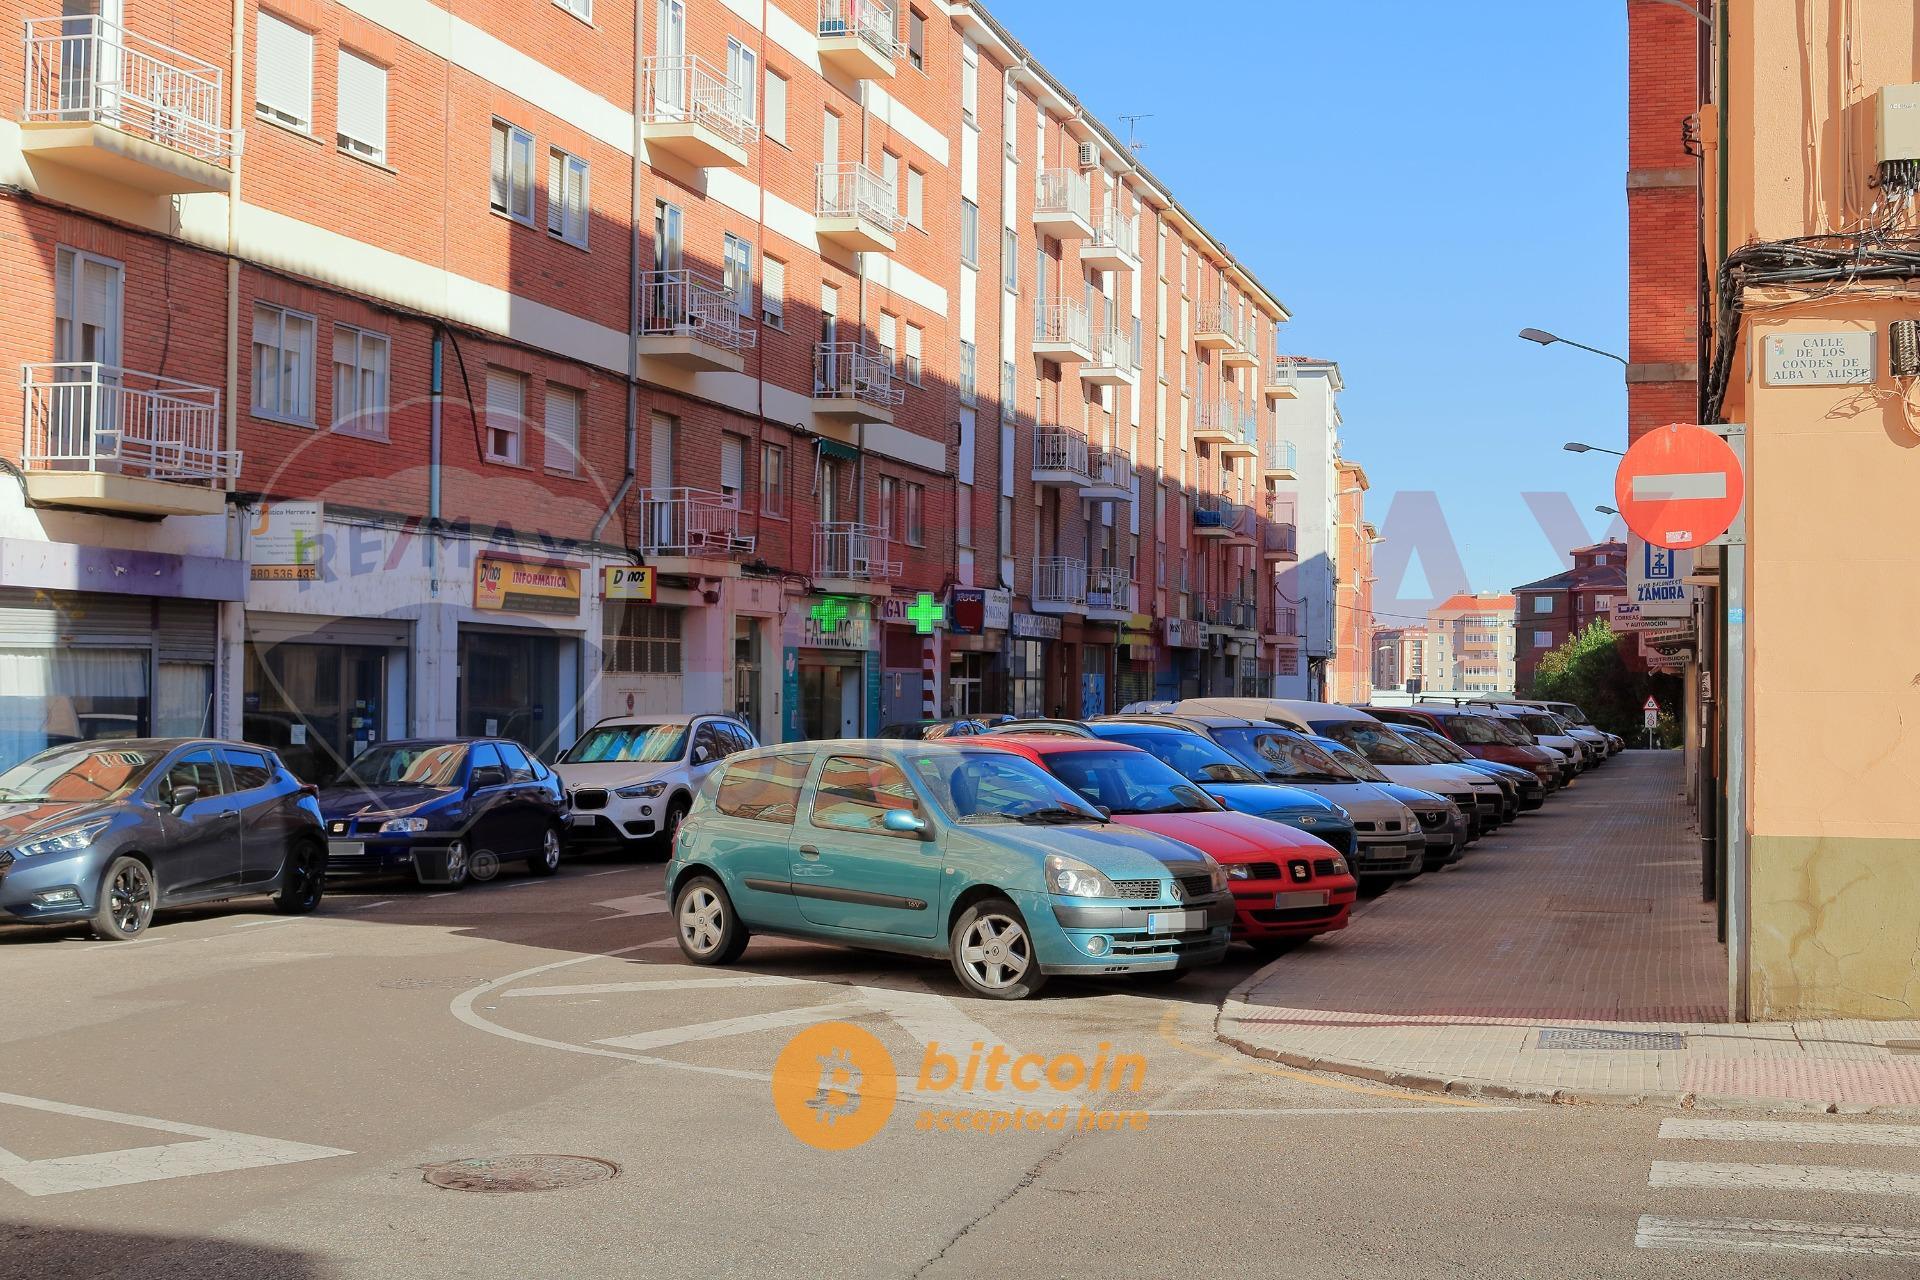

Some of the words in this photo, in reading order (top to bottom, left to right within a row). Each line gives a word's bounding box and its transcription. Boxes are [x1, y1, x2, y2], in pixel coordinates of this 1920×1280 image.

[1803, 338, 1844, 347] CALLE
[1796, 349, 1813, 358] DE
[1822, 347, 1846, 357] LOS
[1782, 359, 1833, 369] CONDES
[1842, 358, 1859, 367] DE
[1773, 370, 1804, 380] ALBA
[1811, 369, 1819, 378] Y
[1826, 368, 1870, 378] ALISTE
[250, 568, 270, 579] 980
[273, 568, 293, 579] 536
[512, 570, 567, 589] INFORMATICA
[1652, 579, 1683, 587] BALONCEST
[1638, 585, 1685, 602] ZAMORA
[1648, 655, 1690, 663] DISTRIBUIDOR
